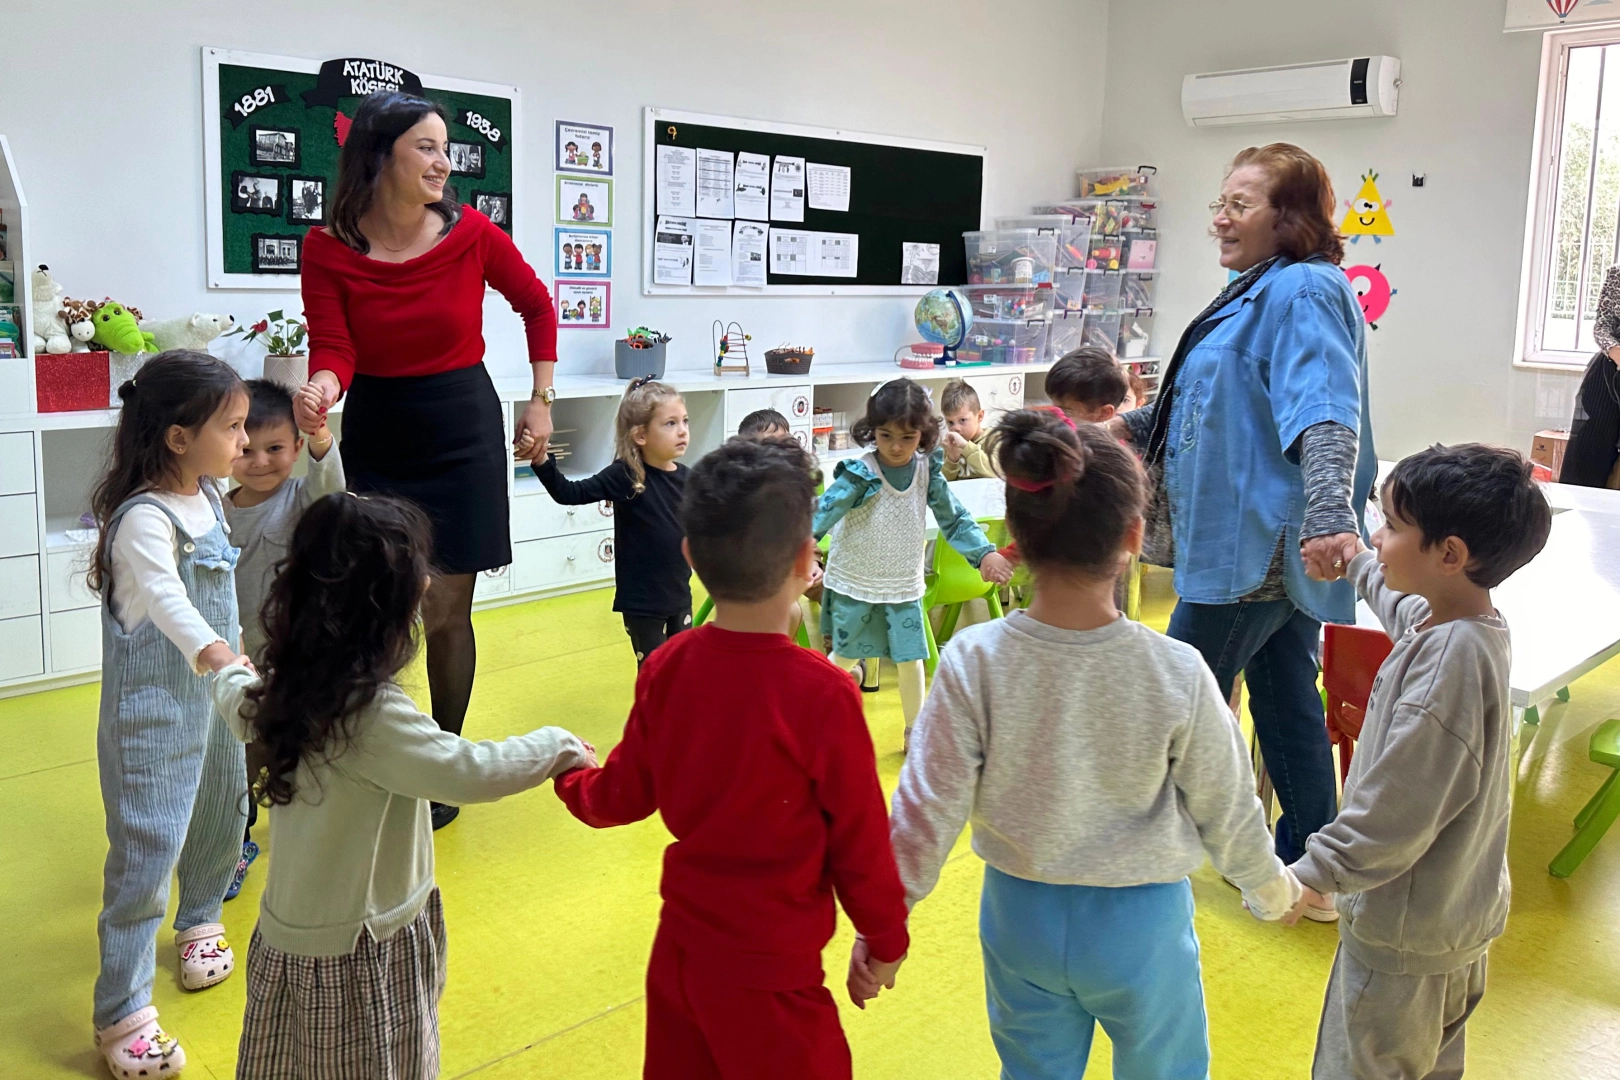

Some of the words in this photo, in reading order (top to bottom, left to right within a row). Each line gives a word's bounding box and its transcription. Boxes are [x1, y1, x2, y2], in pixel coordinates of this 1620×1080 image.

[343, 60, 404, 84] ATATÜRK
[234, 86, 275, 117] 1881
[466, 111, 501, 142] 1938
